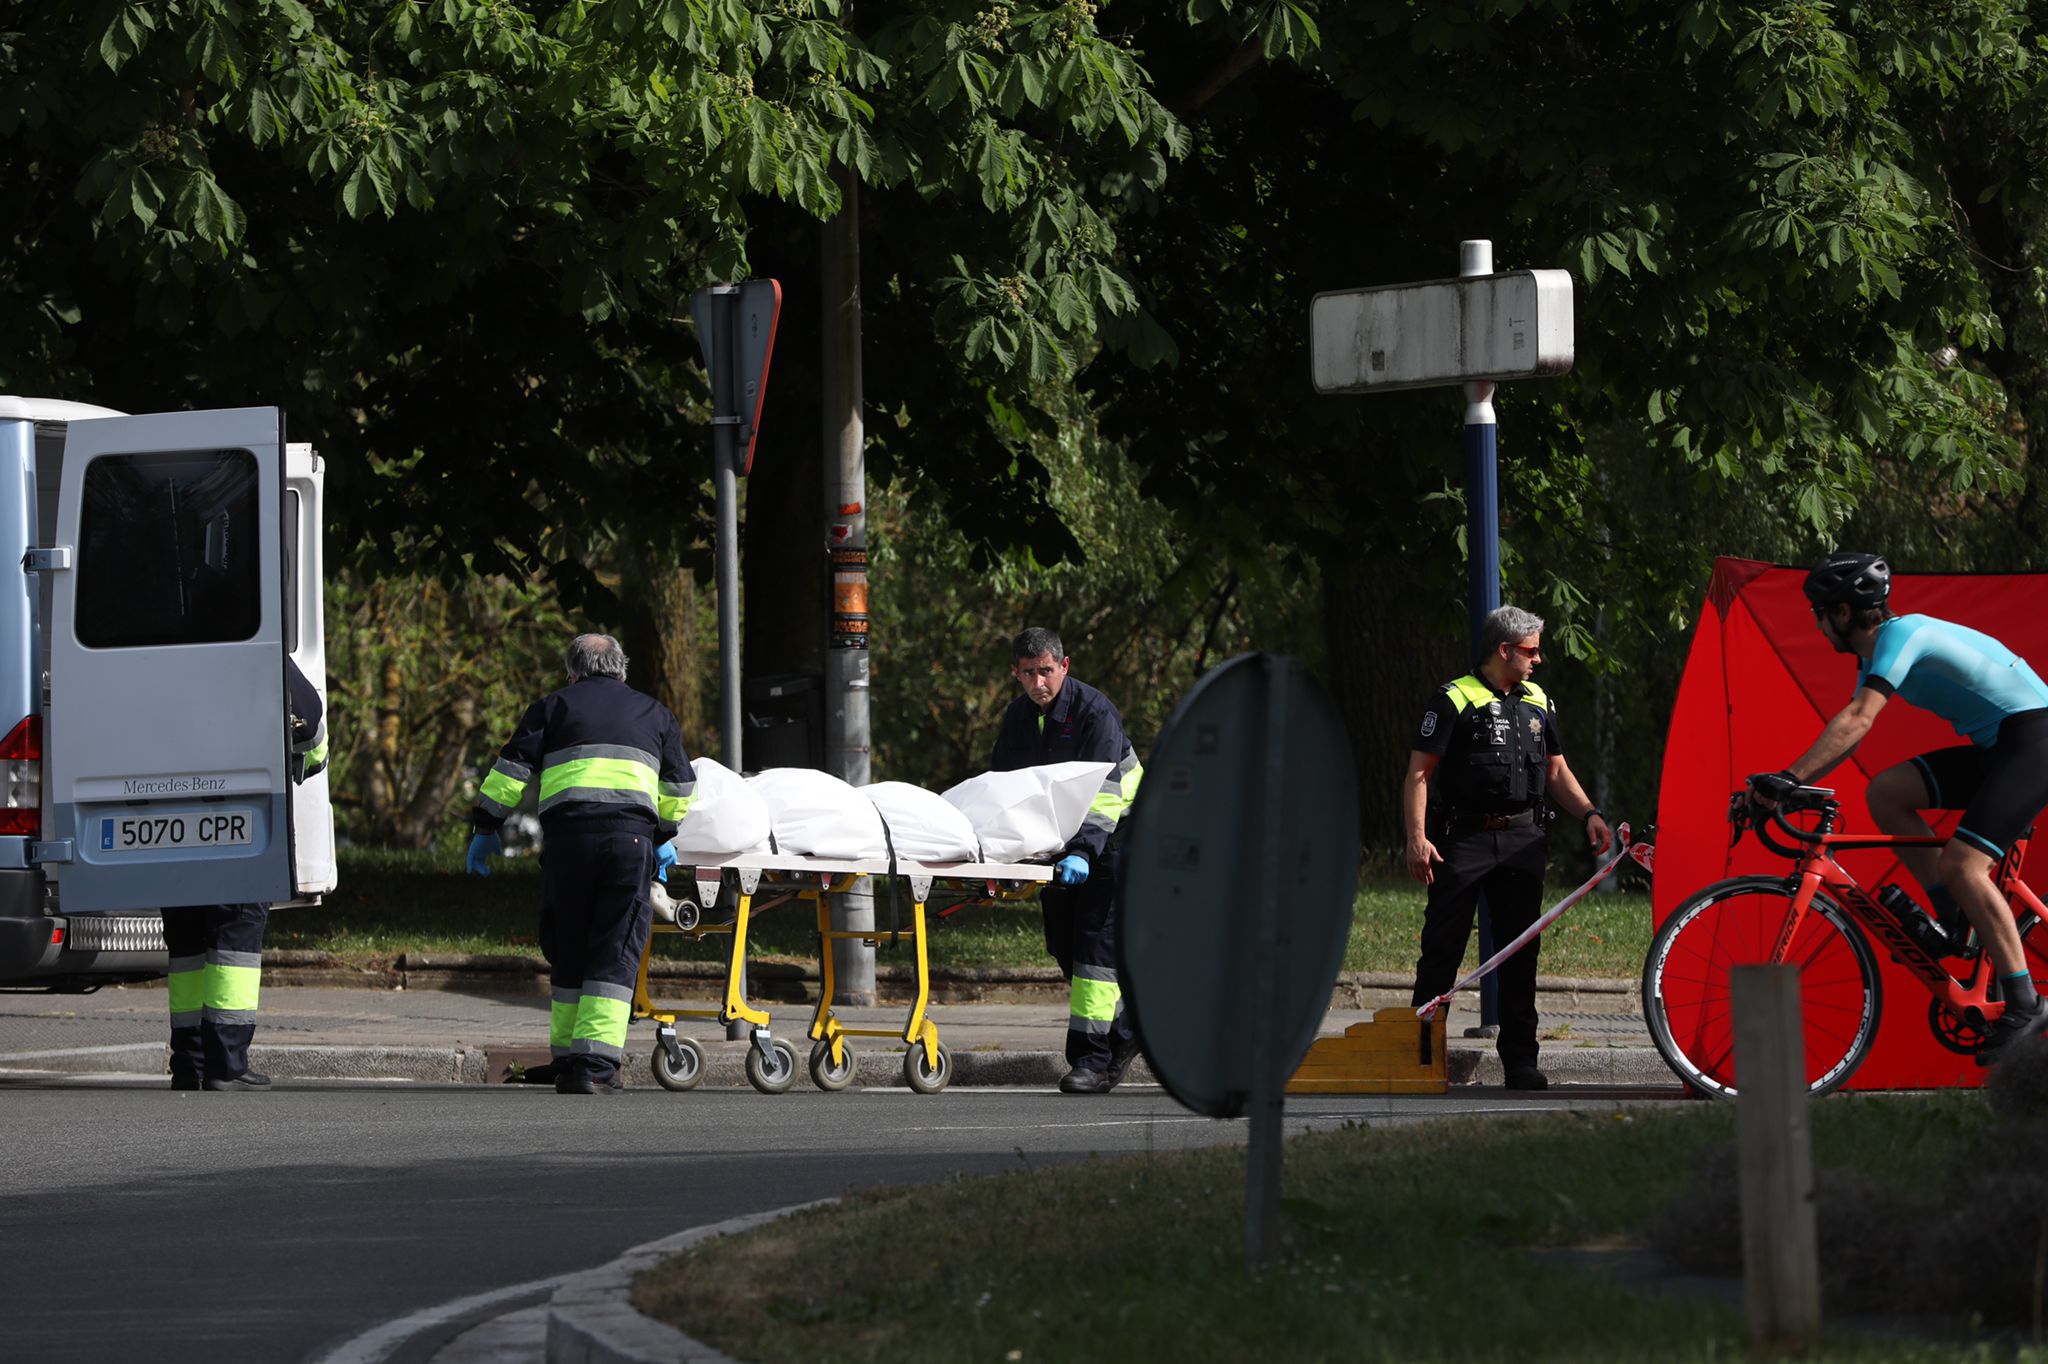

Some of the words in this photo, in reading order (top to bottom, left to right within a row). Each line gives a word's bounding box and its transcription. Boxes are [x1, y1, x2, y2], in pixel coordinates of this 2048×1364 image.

[123, 777, 226, 795] Mercedes-Benz
[122, 818, 185, 846] 5070
[199, 815, 246, 842] CPR
[1774, 909, 1800, 964] ERIDA
[1832, 883, 1950, 981] MERIDA
